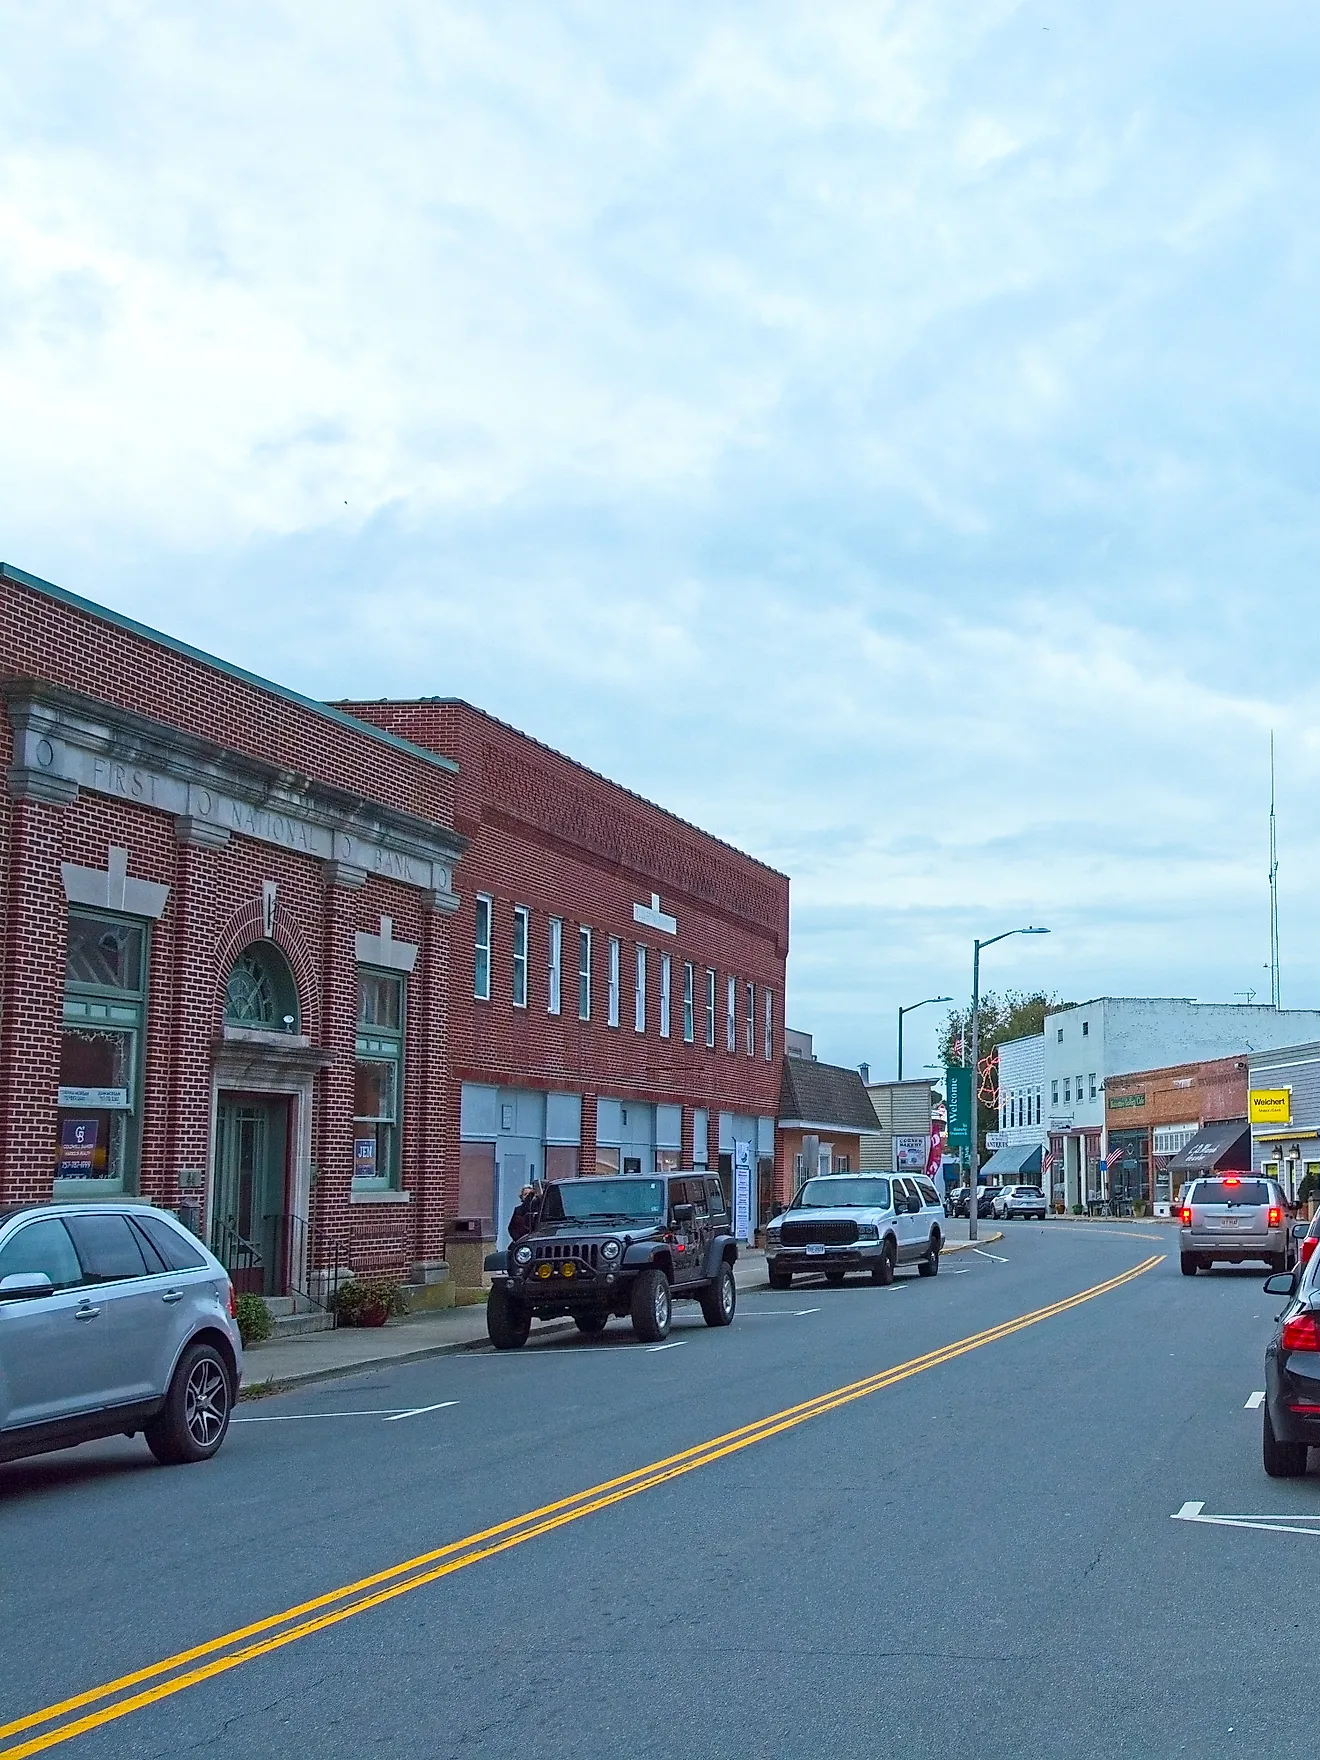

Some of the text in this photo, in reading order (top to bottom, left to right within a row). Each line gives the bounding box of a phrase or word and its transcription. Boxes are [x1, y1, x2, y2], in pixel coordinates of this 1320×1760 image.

[94, 757, 413, 881] FIRST NATIONAL BANK
[949, 1077, 958, 1124] Welcome
[1253, 1098, 1286, 1106] Weichert
